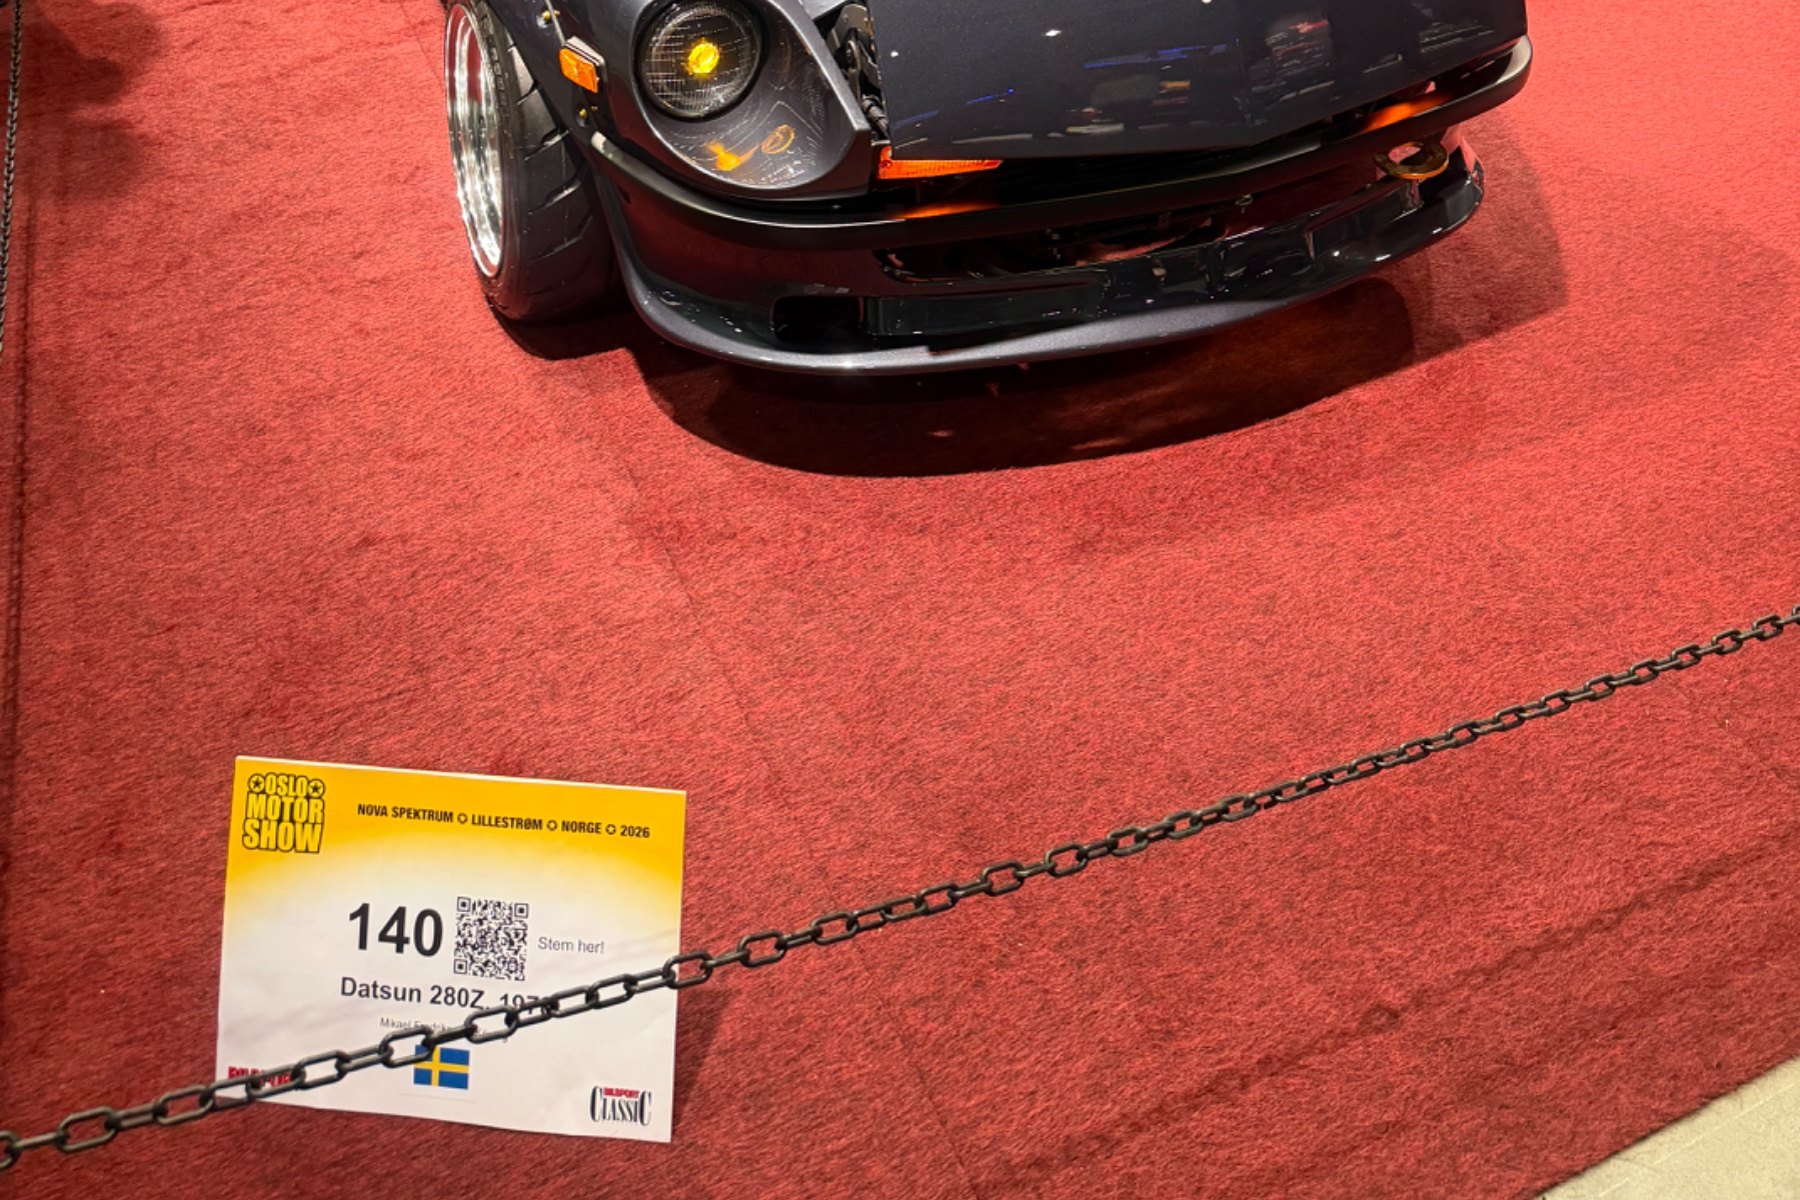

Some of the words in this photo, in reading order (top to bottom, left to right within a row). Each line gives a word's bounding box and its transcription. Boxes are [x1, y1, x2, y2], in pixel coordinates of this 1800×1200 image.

[265, 772, 309, 797] OSLO
[245, 791, 325, 823] MOTOR
[357, 803, 388, 817] NOVA
[391, 806, 453, 823] SPEKTRUM
[471, 813, 543, 830] LILLESTRØM
[561, 820, 601, 834] NORGE
[620, 825, 650, 838] 2026
[242, 818, 322, 853] SHOW
[349, 902, 443, 958] 140
[538, 936, 574, 951] Stem
[577, 939, 605, 954] her!
[341, 976, 422, 1003] Datsun
[499, 992, 552, 1015] 197
[590, 1085, 652, 1127] CLASSIC
